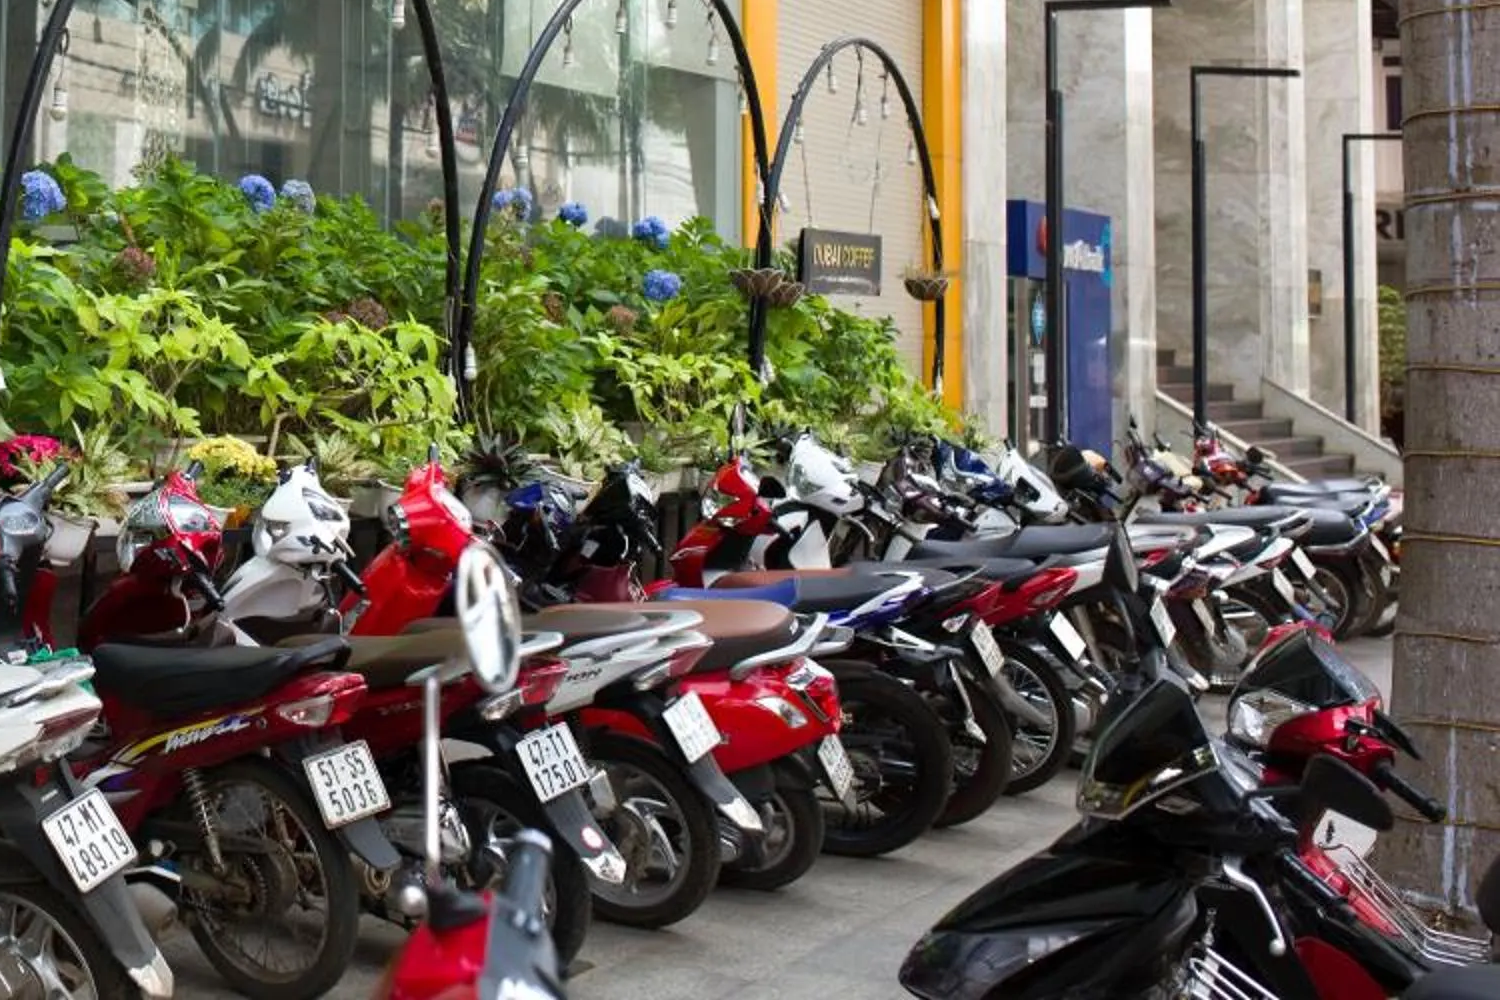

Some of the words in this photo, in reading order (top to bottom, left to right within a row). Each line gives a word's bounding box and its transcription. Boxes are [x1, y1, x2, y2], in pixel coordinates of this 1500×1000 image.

[535, 754, 587, 797] 175.01
[328, 779, 378, 816] 5036
[68, 827, 130, 883] 489.19
